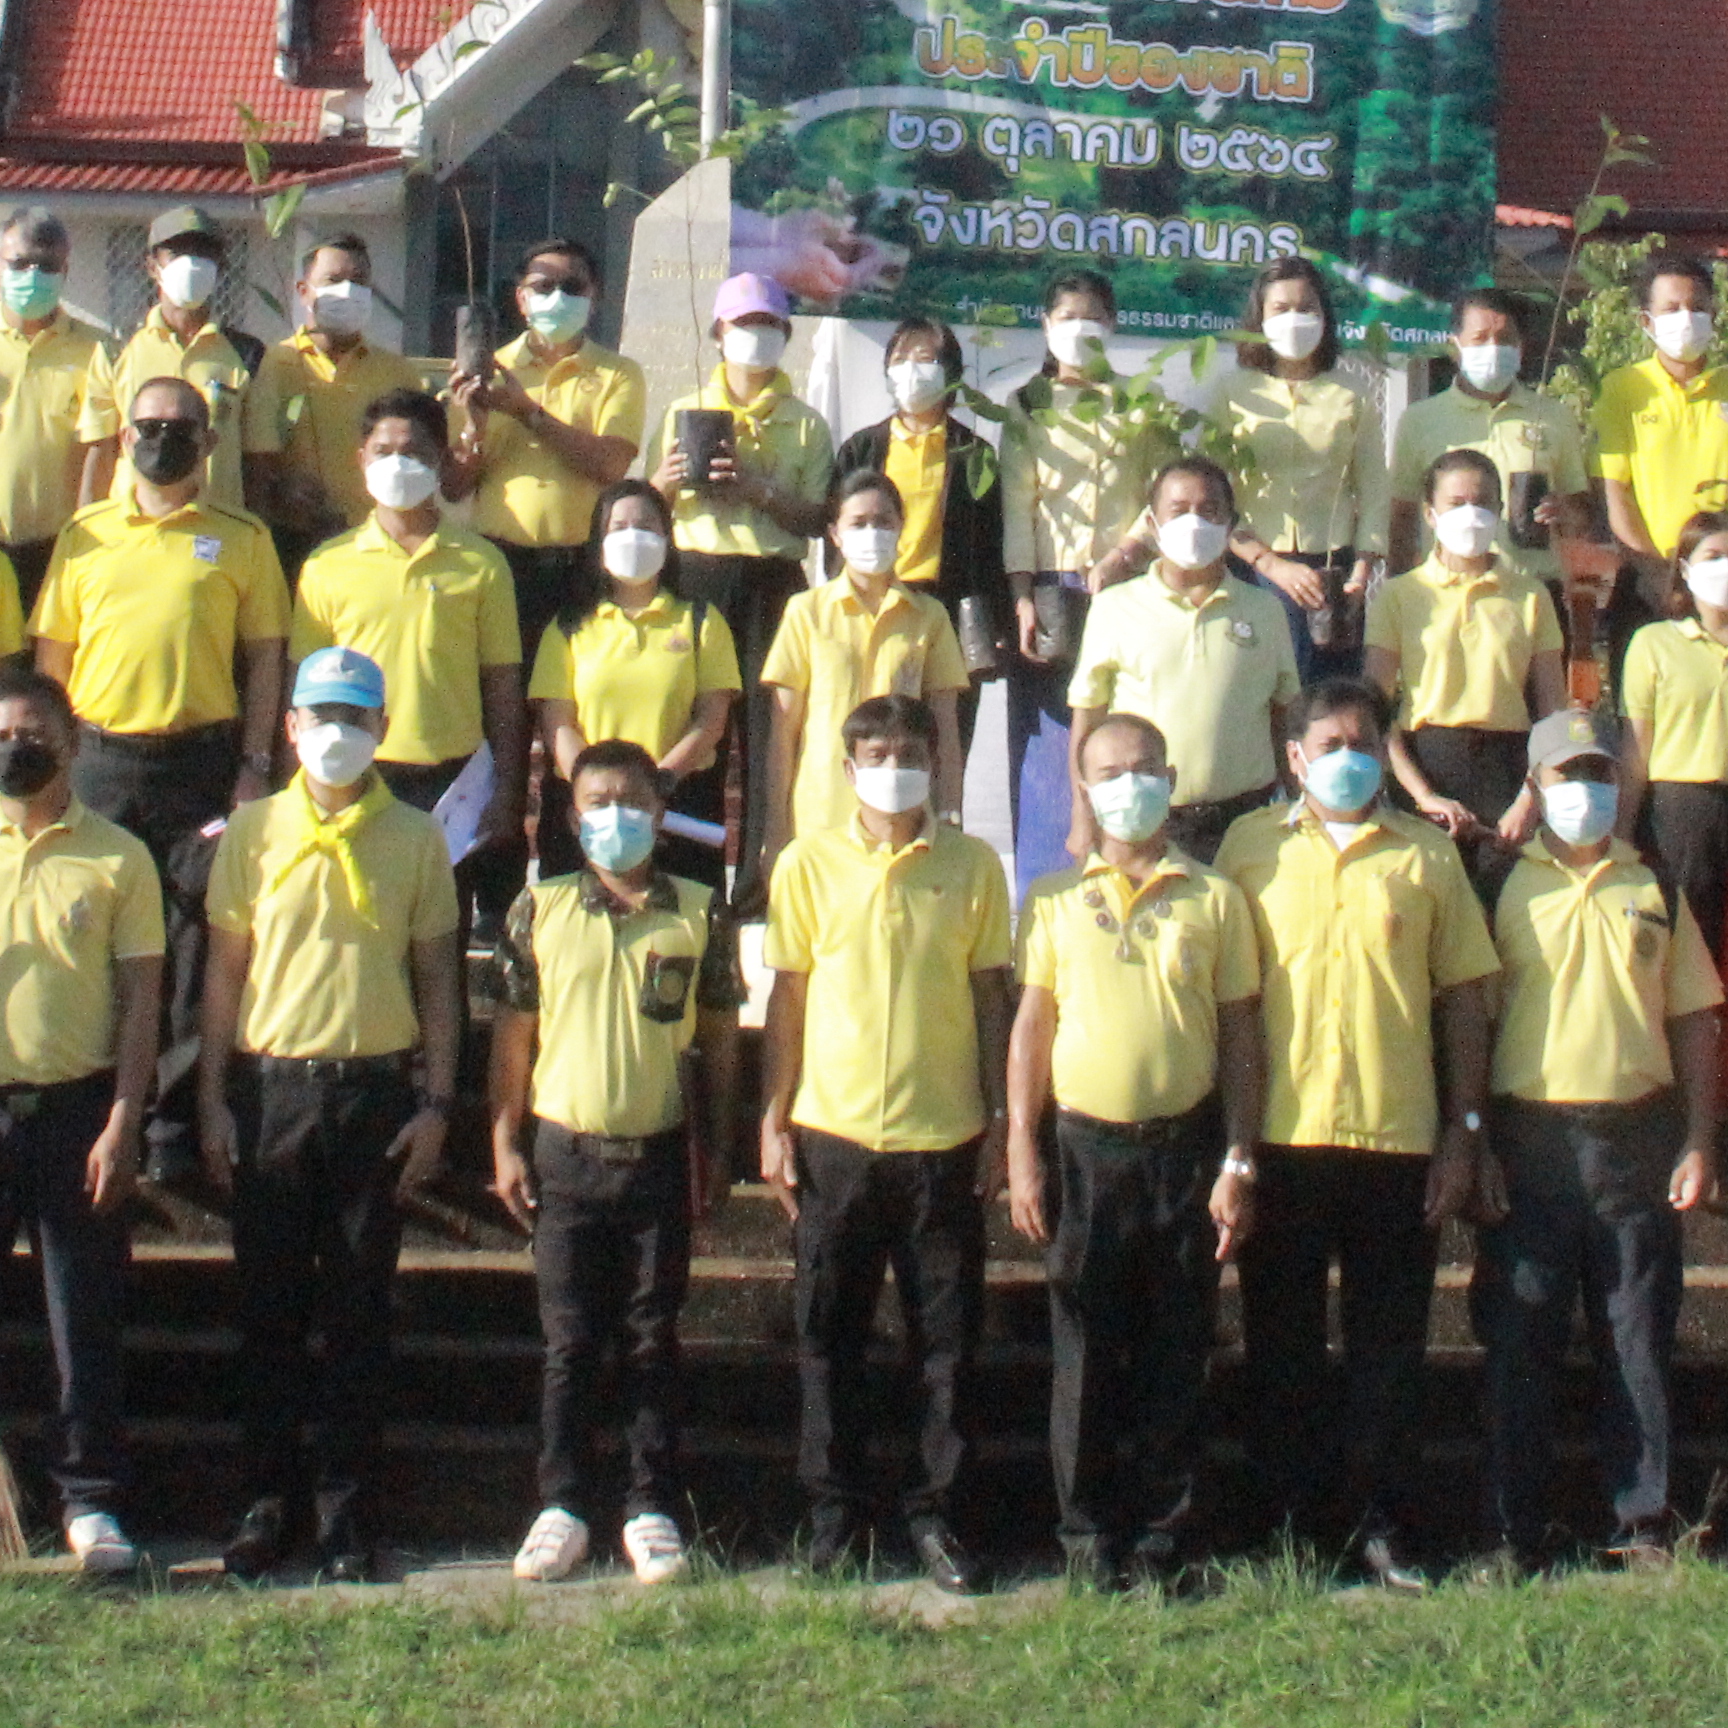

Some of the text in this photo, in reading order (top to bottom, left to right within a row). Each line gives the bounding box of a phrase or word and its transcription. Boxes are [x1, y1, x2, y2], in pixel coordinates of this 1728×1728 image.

[913, 14, 1313, 101] ประจำปีของชาติ
[887, 110, 1334, 177] ๒๑ ตุลาคม ๒๕๖๔
[913, 191, 1299, 263] จังหวัดสกลนคร
